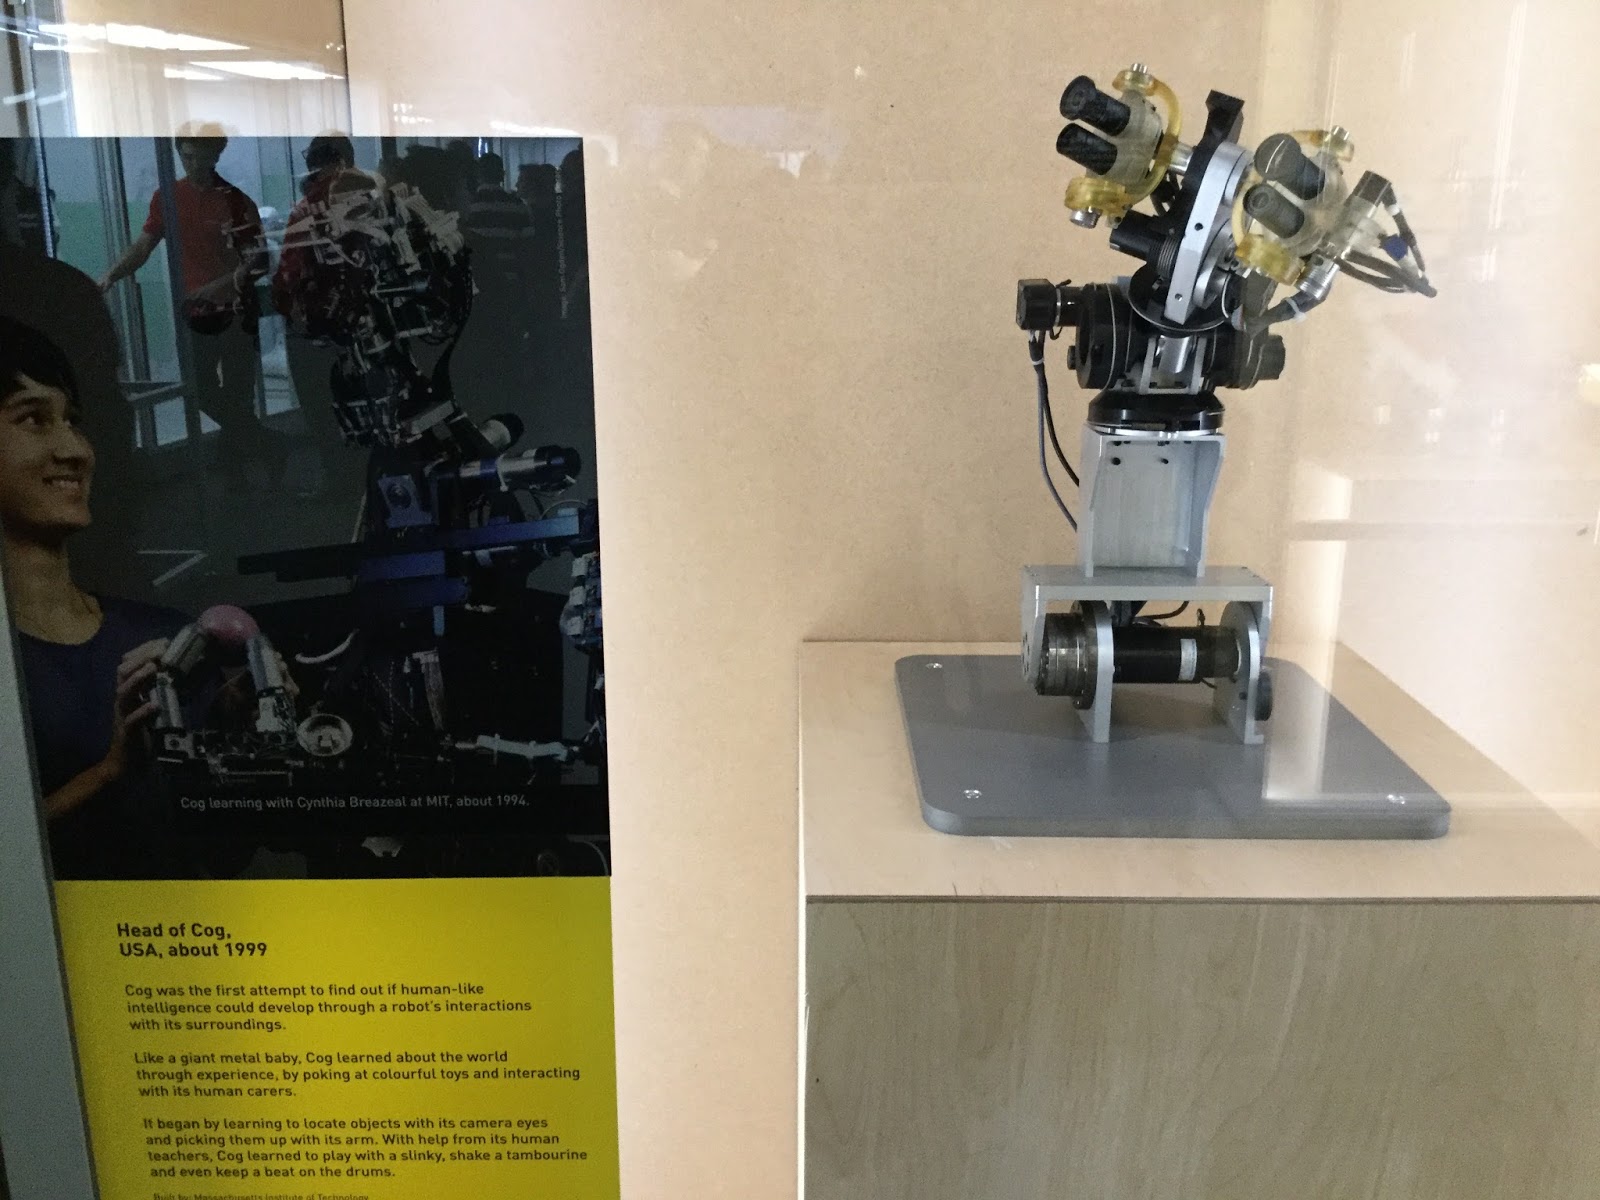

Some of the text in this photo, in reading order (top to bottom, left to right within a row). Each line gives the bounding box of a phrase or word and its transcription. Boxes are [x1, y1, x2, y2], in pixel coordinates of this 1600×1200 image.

[180, 794, 530, 812] Cog learning with Cynthia Breazeal at MIT, about 1994.
[116, 922, 232, 941] Head of Cog,
[119, 941, 268, 959] USA, about 1999
[124, 982, 485, 1000] Cog was the first attempt to find out if human-like
[127, 1002, 212, 1016] intelligence
[215, 1001, 254, 1014] could
[258, 1001, 315, 1016] develop
[317, 1001, 376, 1016] through
[379, 1003, 388, 1013] a
[445, 999, 533, 1012] interactions
[129, 1018, 286, 1033] with its surroundings.
[134, 1050, 508, 1067] Like a giant metal baby, Cog learned about the world
[136, 1066, 581, 1083] through experience, by poking at colourful toys and interacting
[138, 1085, 297, 1097] with its human carers.
[143, 1117, 549, 1132] It began by learning to locate objects with its camera eyes
[145, 1133, 560, 1148] and picking them up with its arm. With help from its human
[147, 1149, 588, 1164] teachers, Cog learned to play with a slinky, shake a tambourine
[150, 1166, 396, 1180] and even keep a beat on the drums.
